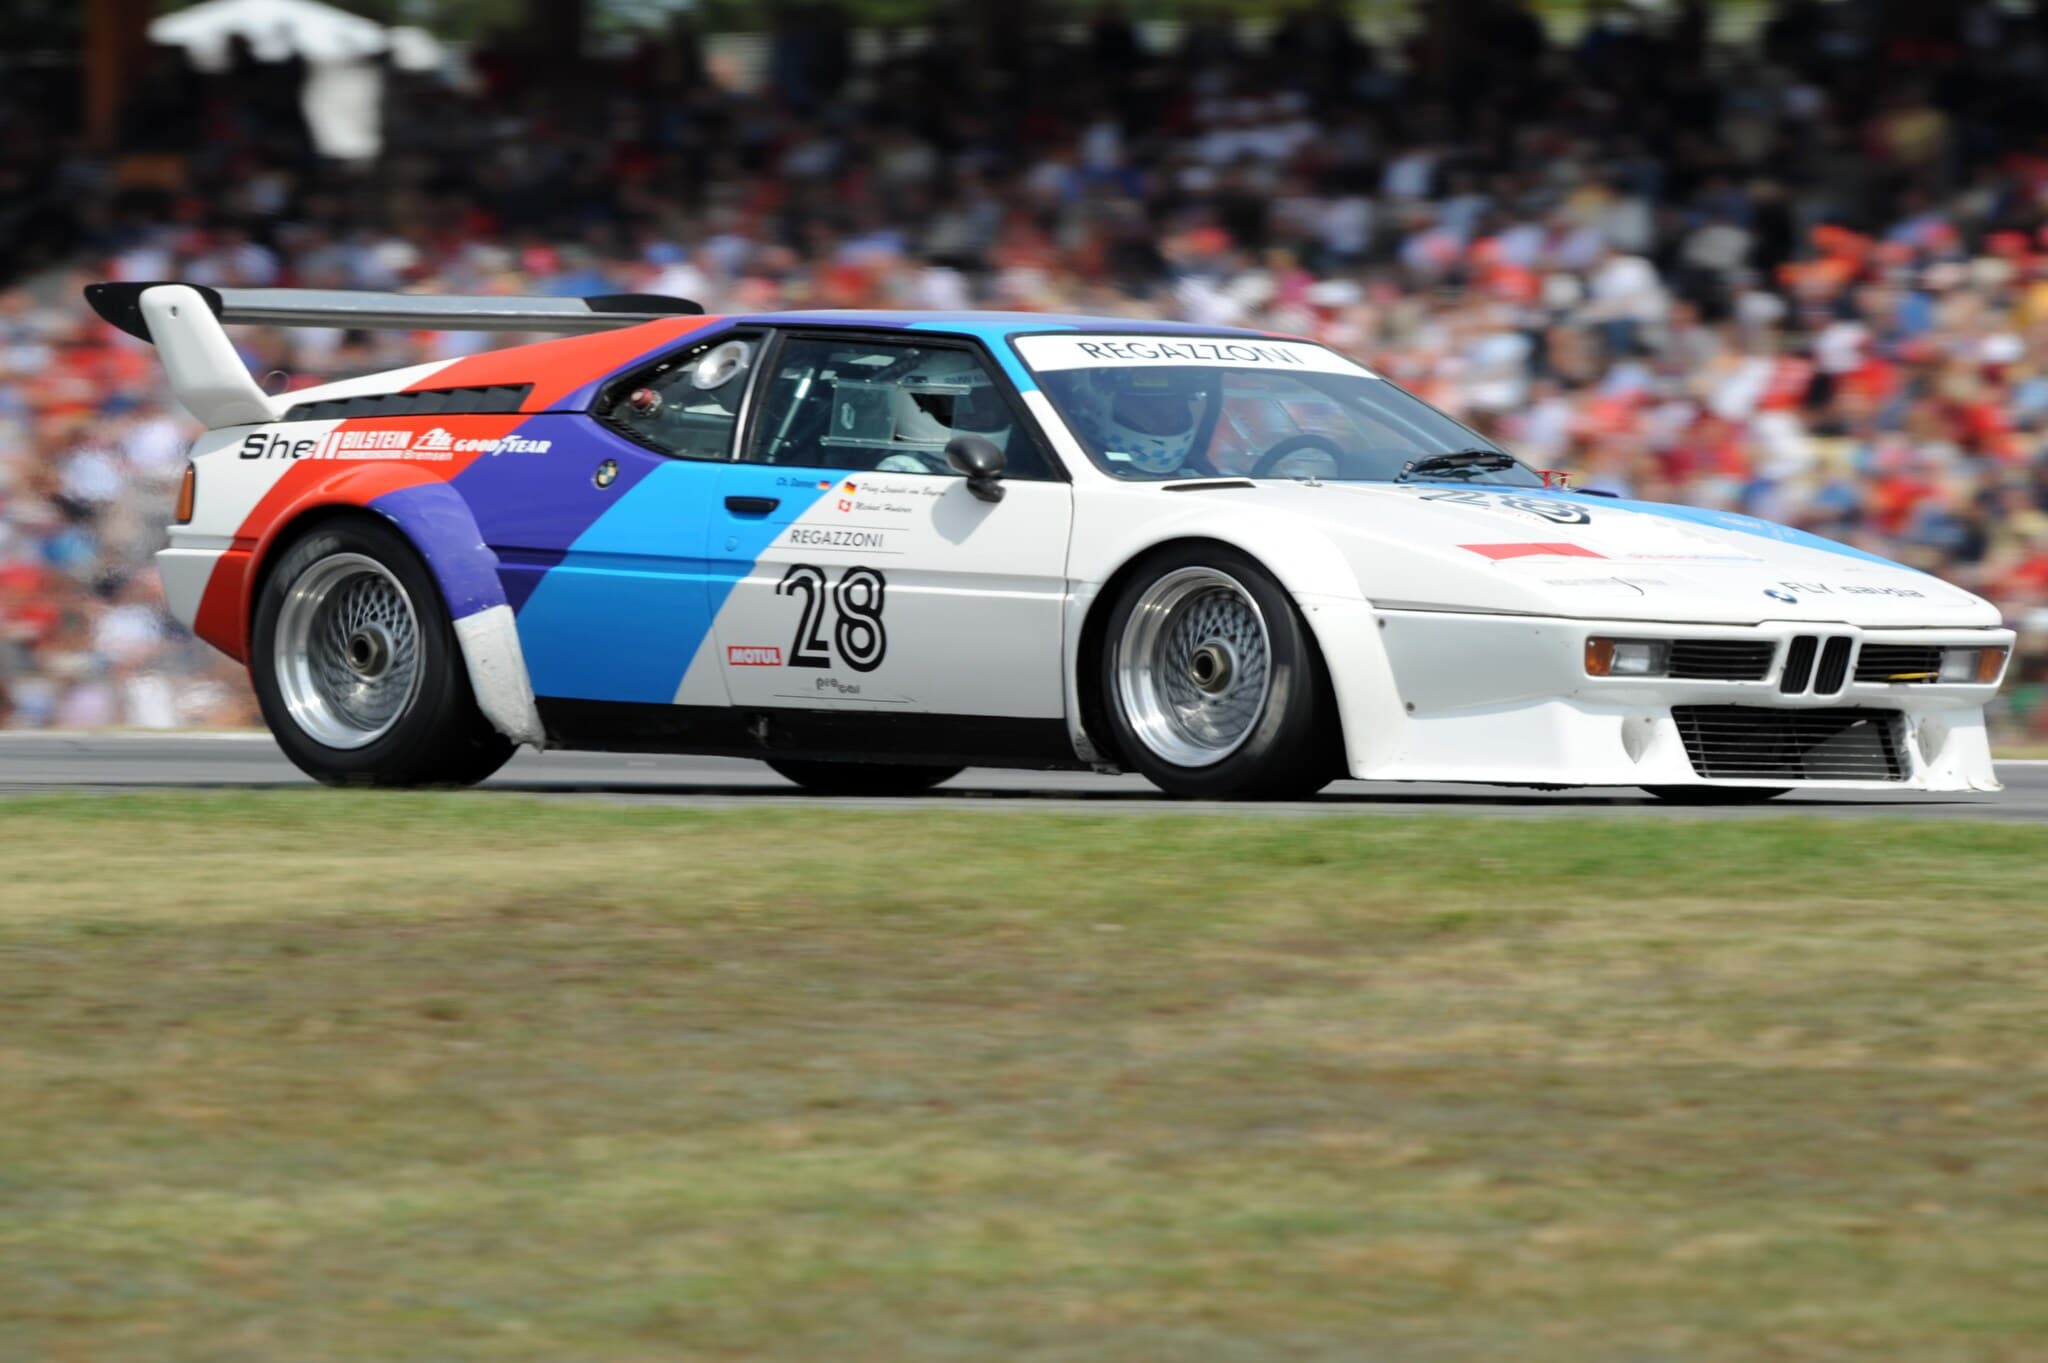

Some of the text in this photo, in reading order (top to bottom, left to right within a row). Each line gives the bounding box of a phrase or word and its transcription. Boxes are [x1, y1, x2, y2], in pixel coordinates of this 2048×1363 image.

[1076, 341, 1305, 364] REGAZZONI
[238, 432, 338, 461] Shell
[339, 431, 414, 450] BILSTEIN
[453, 435, 552, 457] GOODYEAR
[790, 529, 885, 548] REGAZZONI
[776, 564, 887, 673] 28
[730, 647, 781, 665] MOTUL
